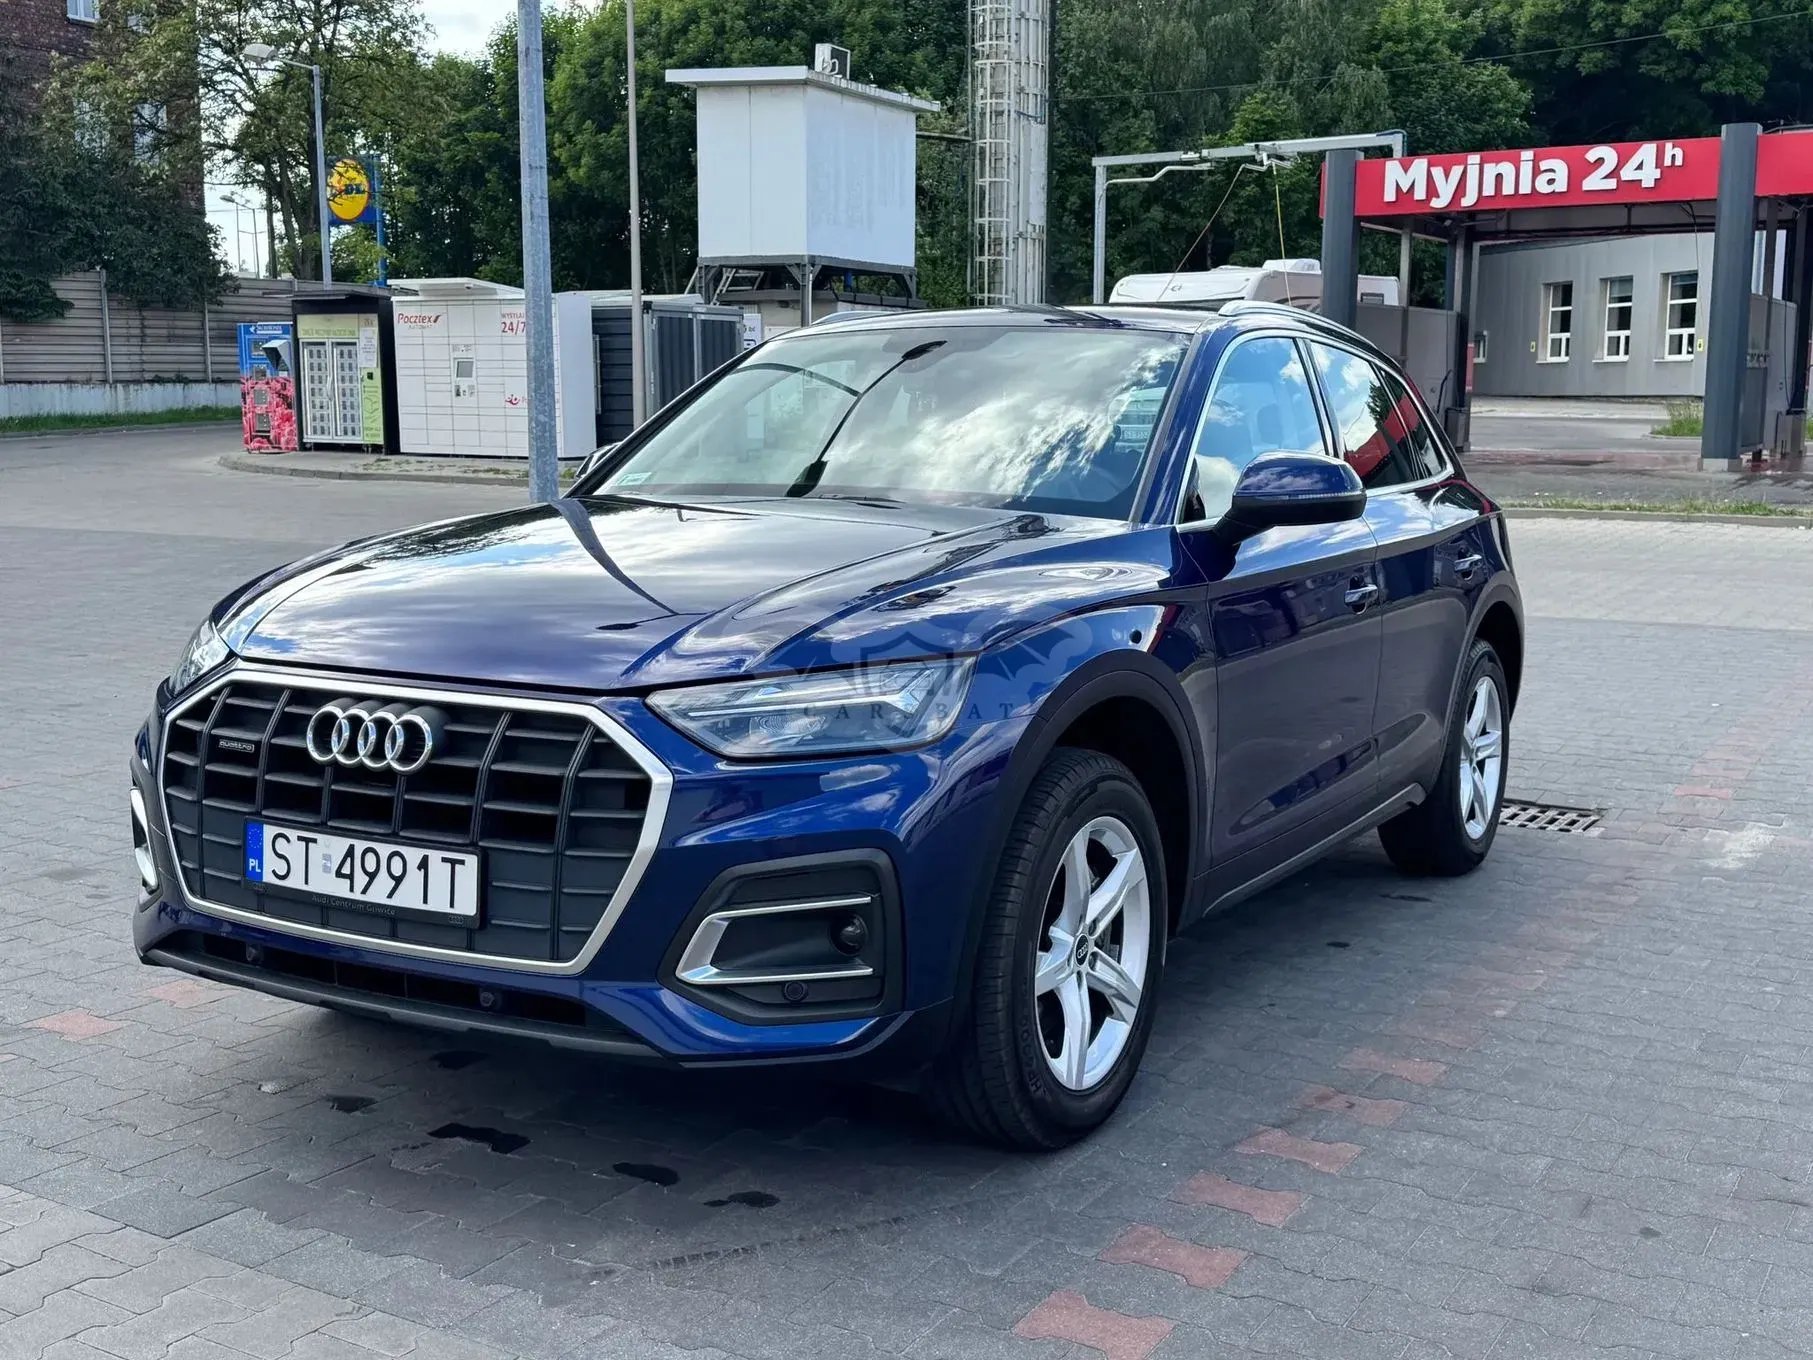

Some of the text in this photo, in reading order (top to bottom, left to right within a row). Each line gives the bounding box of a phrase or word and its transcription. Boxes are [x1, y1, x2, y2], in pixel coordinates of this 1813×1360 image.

[1382, 150, 1569, 209] Myjnia
[397, 312, 433, 324] Pocztex
[501, 320, 526, 335] 24/7
[219, 740, 252, 751] quattro
[248, 857, 262, 873] PL
[271, 832, 466, 909] ST 4991T
[312, 894, 329, 905] Audi
[330, 897, 365, 912] Centrum
